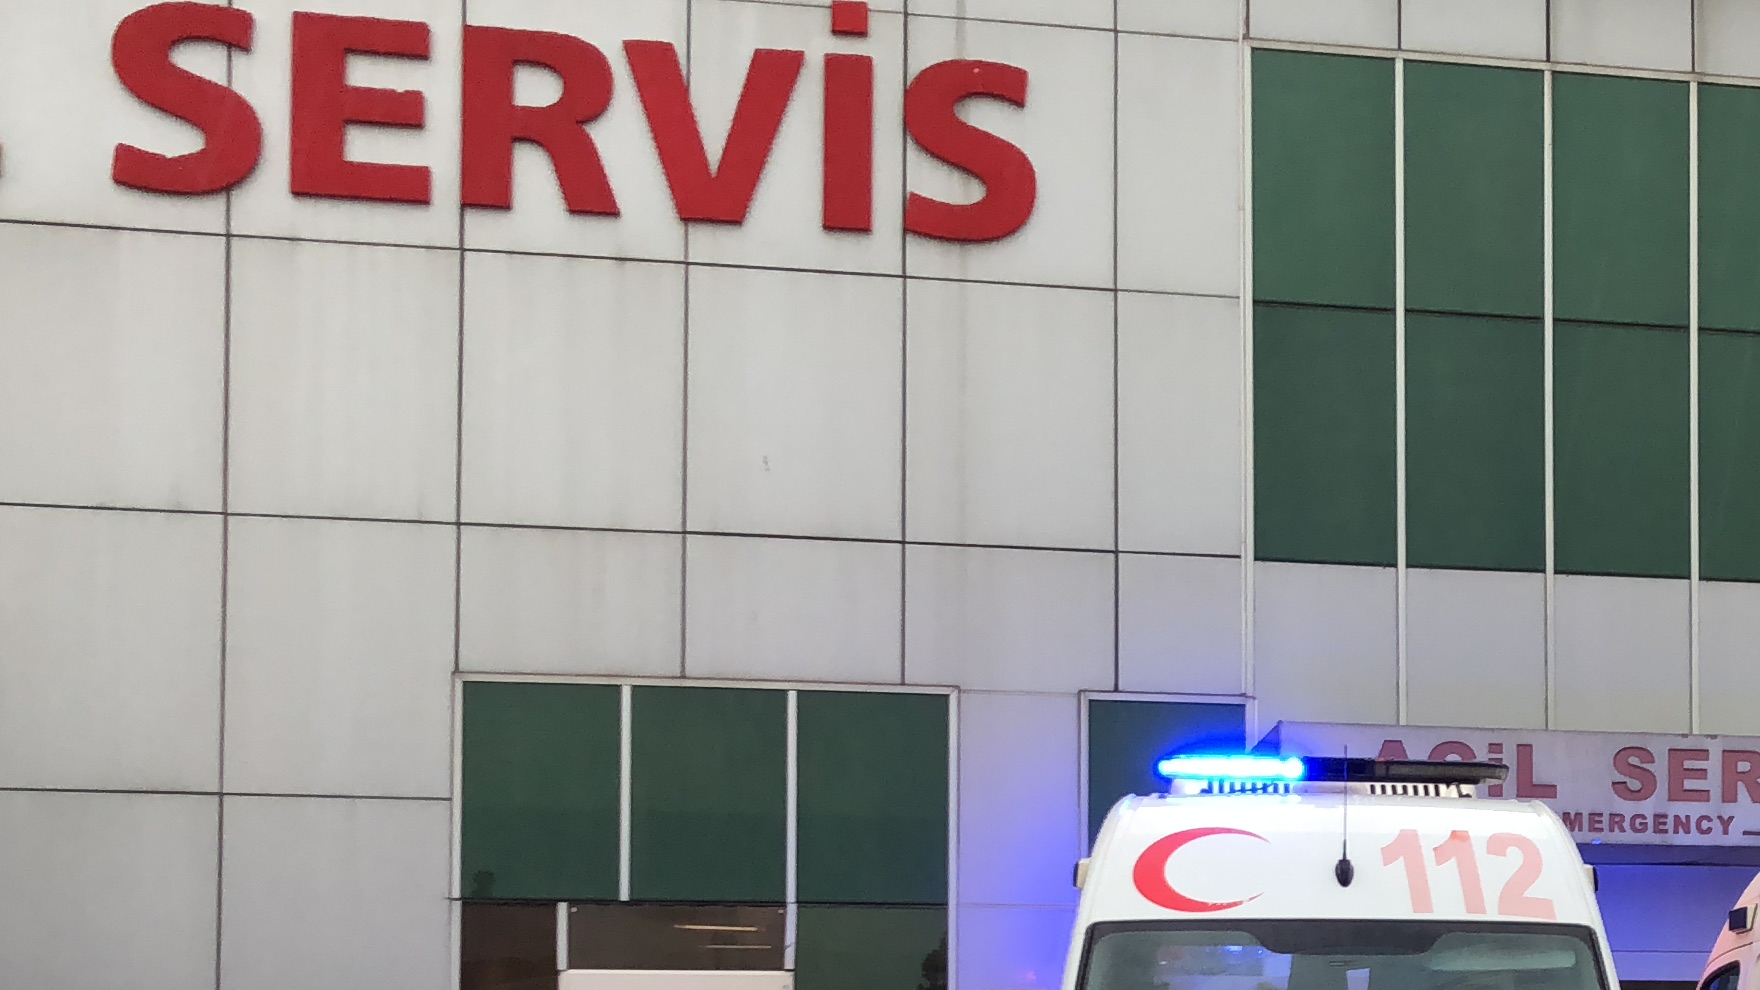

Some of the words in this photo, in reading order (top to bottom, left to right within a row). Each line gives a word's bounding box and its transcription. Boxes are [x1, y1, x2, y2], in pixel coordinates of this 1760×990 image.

[111, 1, 1037, 243] SERVİS
[1562, 812, 1735, 835] MERGENCY
[1380, 829, 1557, 920] 112
